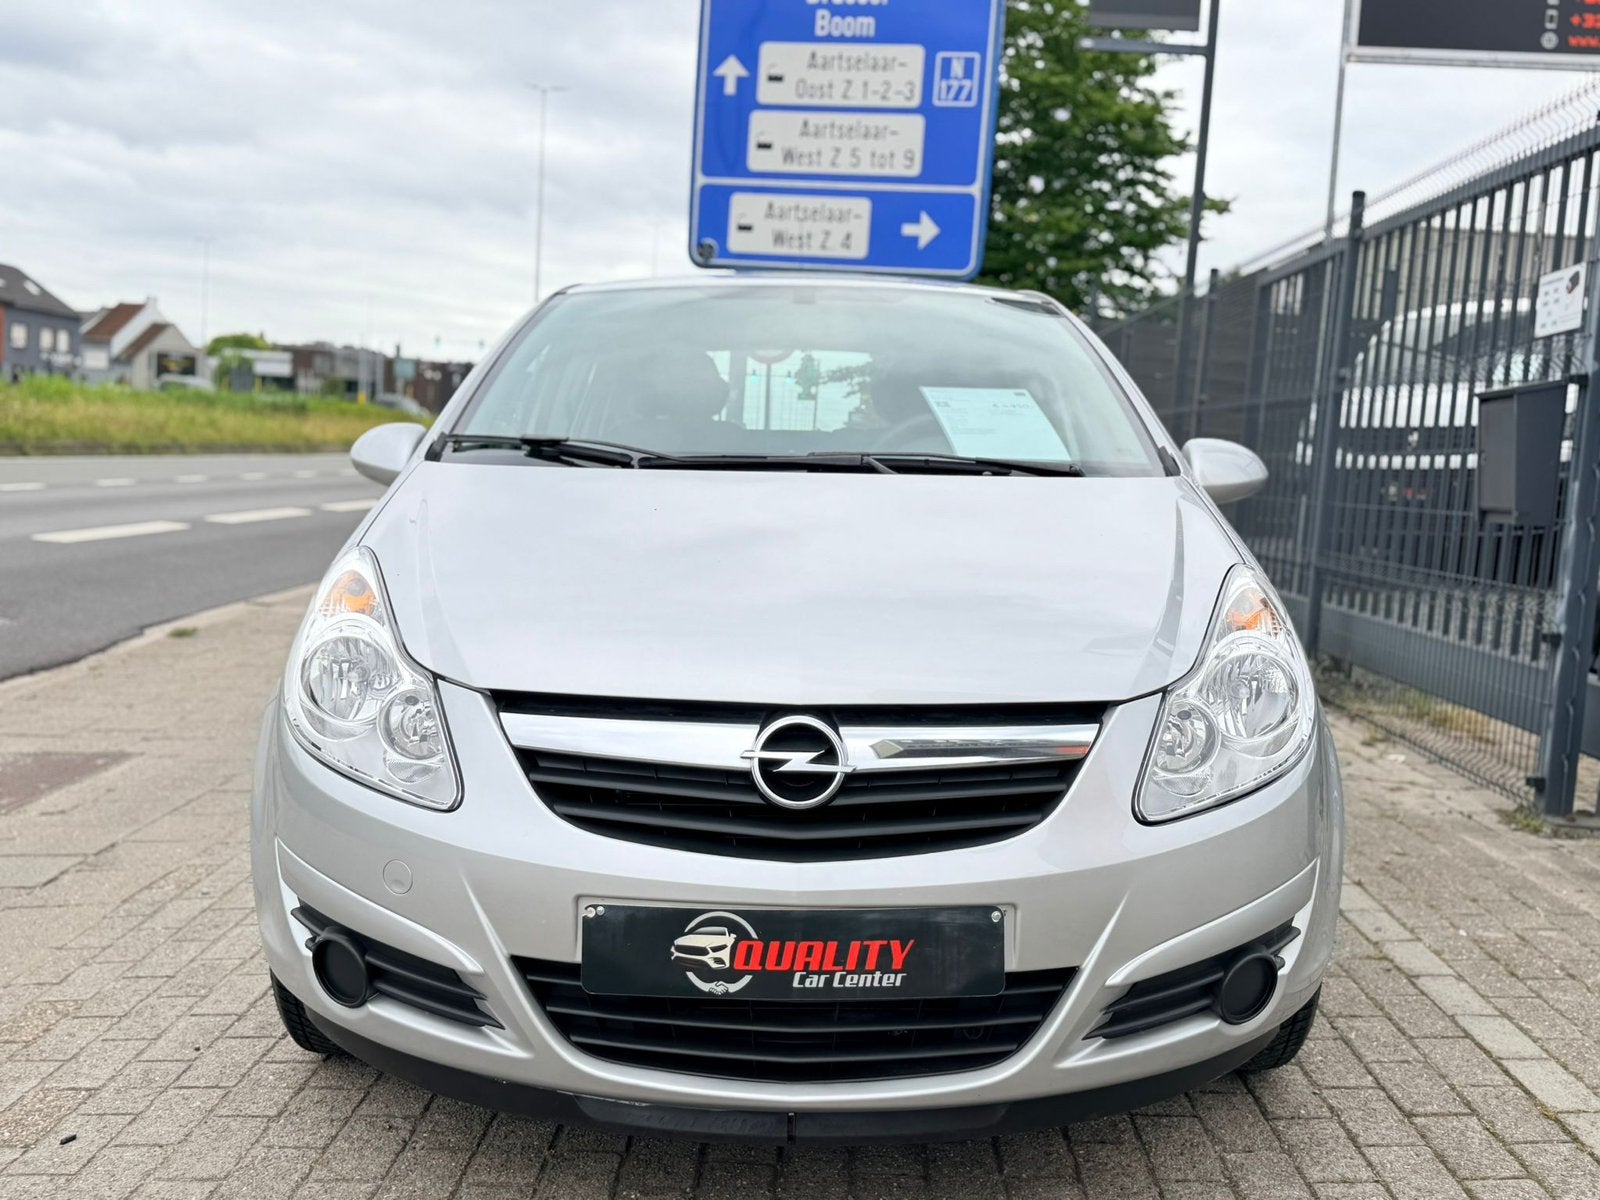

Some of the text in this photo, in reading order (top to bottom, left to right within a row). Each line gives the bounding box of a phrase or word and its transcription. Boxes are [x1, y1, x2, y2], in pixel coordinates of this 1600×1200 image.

[814, 8, 876, 38] Boom
[806, 51, 908, 72] Aartselaar-
[950, 57, 965, 79] N
[795, 78, 834, 100] Oost
[842, 79, 853, 100] Z
[939, 79, 972, 101] 177
[799, 119, 899, 140] Aartselaar-
[781, 147, 916, 170] West Z 5 tot 9
[764, 201, 863, 223] Aartselaar-
[771, 229, 852, 250] West Z 4
[733, 939, 915, 971] QUALITY
[792, 972, 907, 988] Car Center
